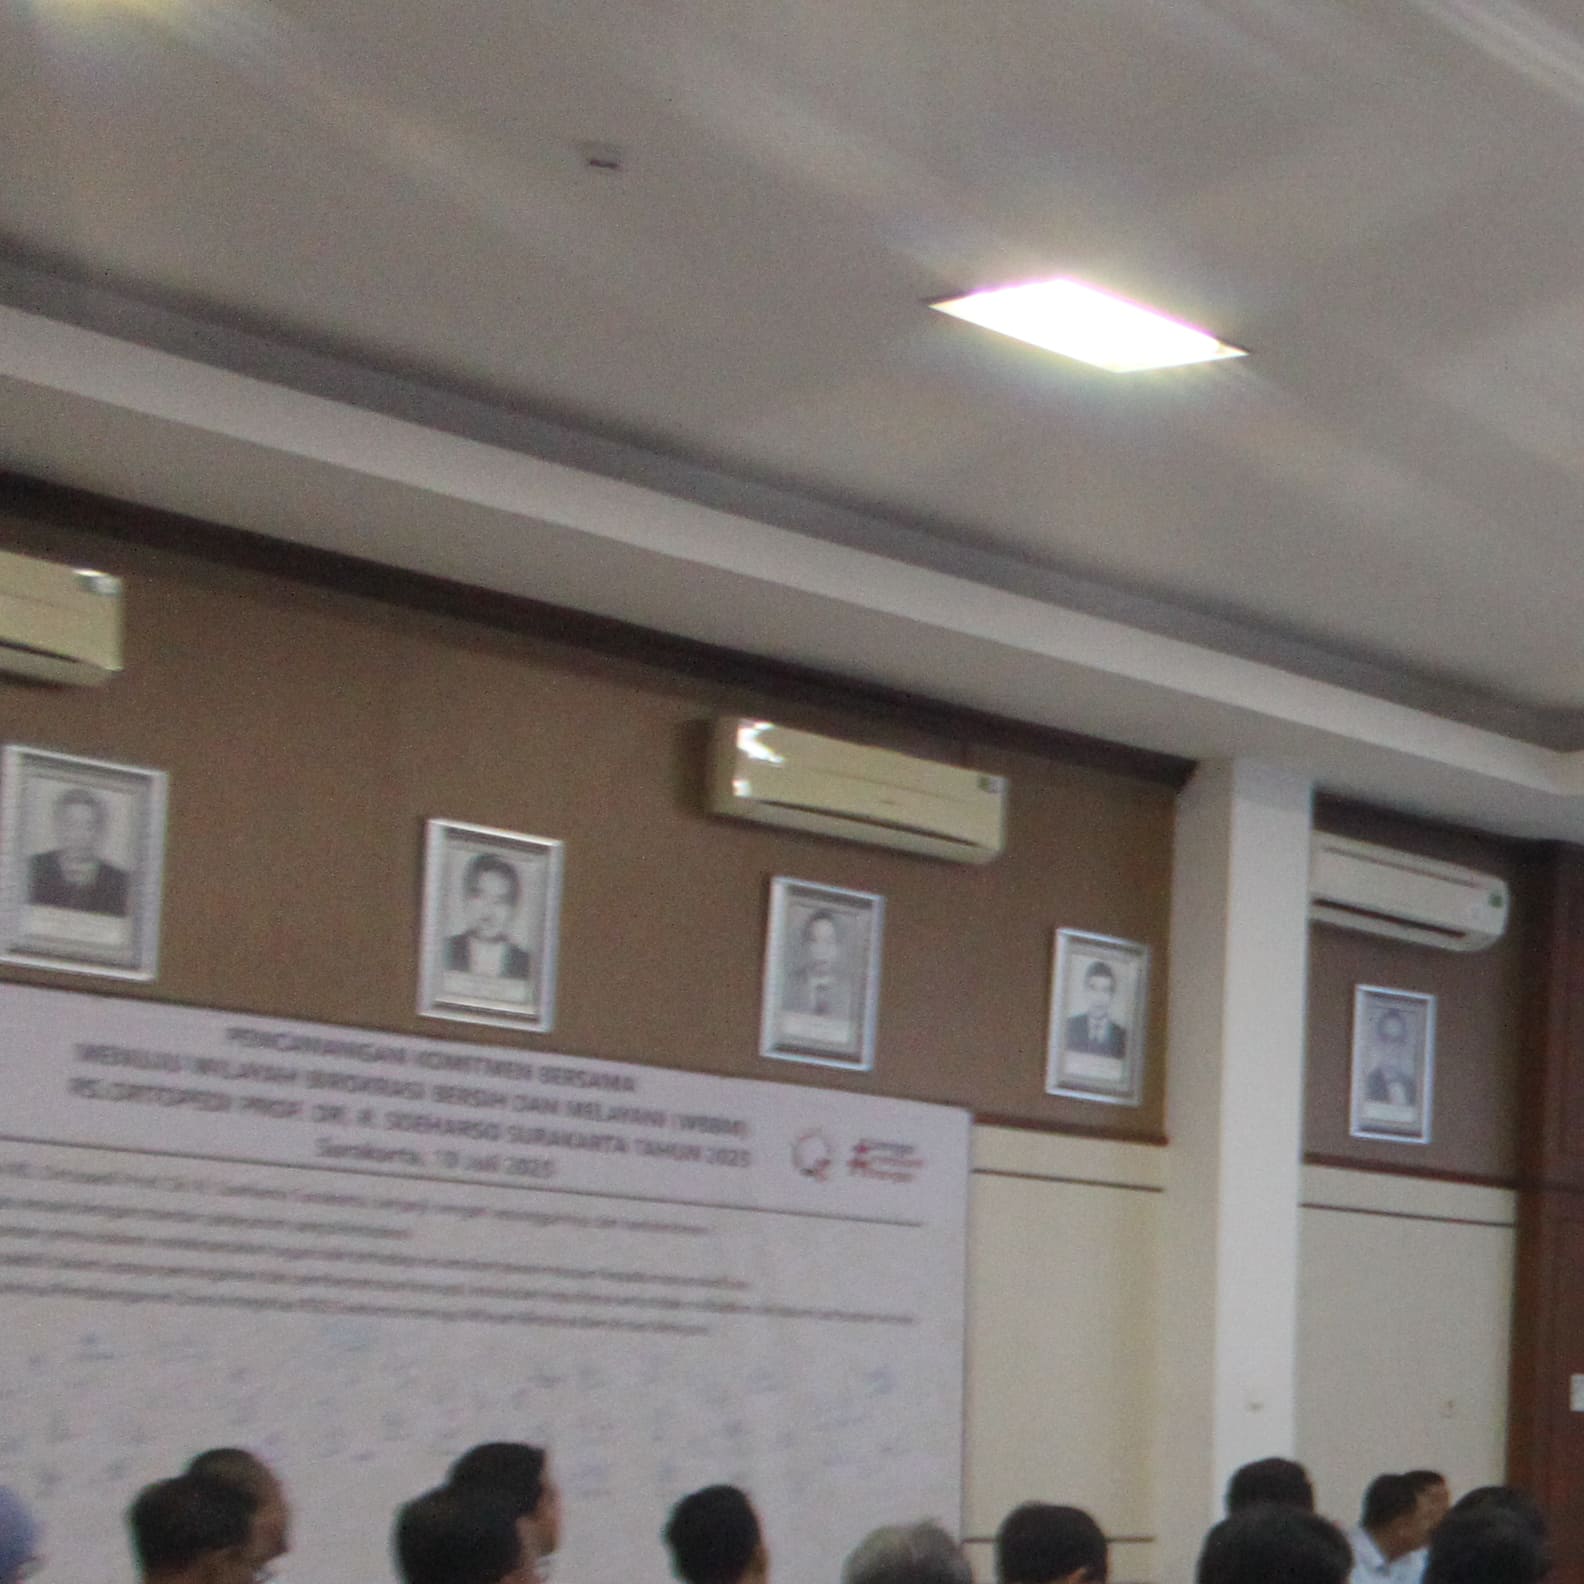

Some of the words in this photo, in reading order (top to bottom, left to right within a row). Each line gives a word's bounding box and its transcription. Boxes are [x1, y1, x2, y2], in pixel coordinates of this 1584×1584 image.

[416, 1048, 535, 1080] KOMITMEN
[538, 1063, 637, 1093] BERSAMA
[512, 1091, 560, 1116] DAN
[505, 1125, 629, 1156] SURAKARTA
[633, 1138, 701, 1164] TAHUN
[705, 1146, 752, 1170] 2025
